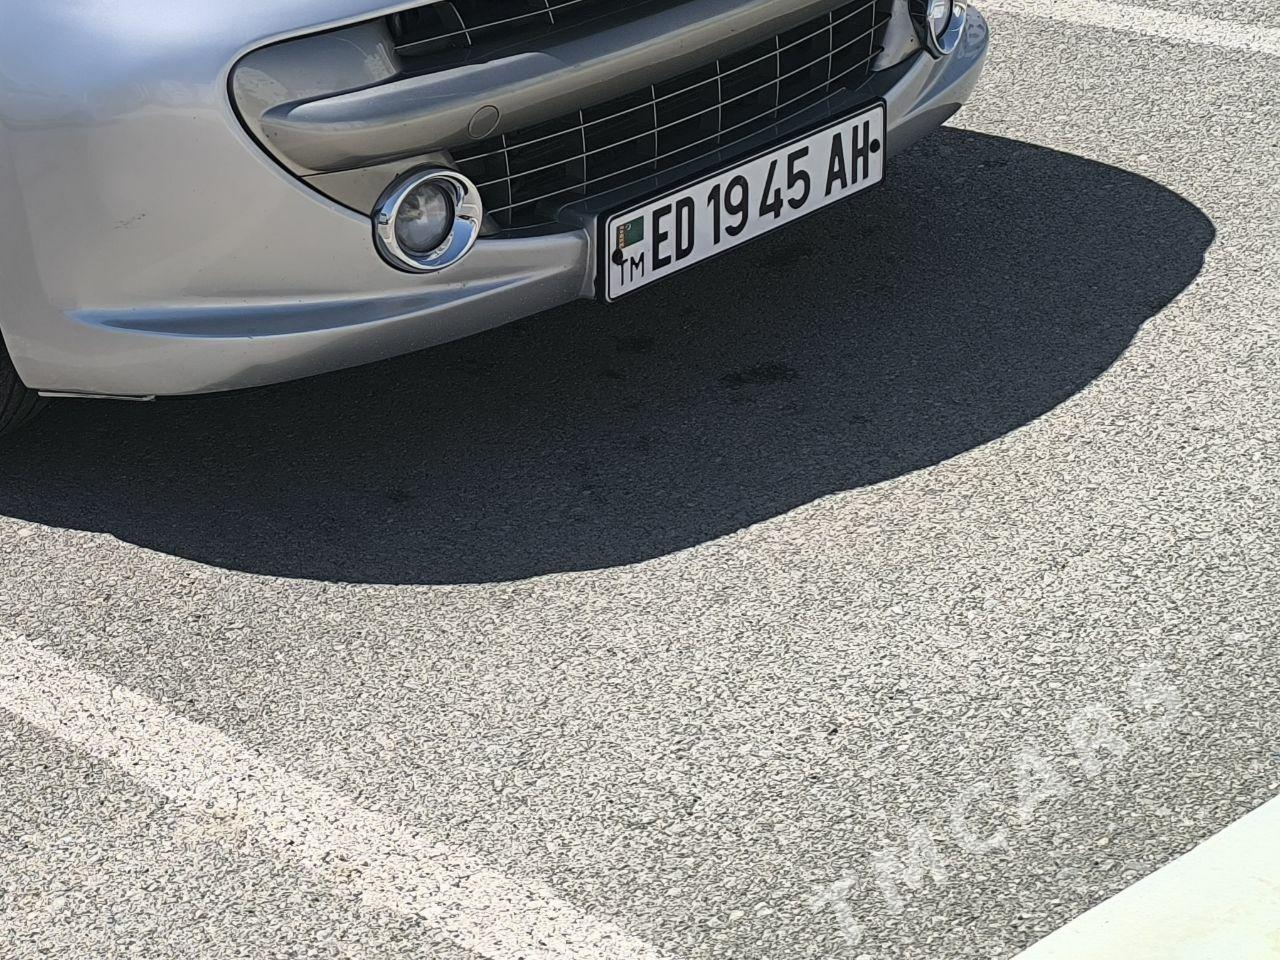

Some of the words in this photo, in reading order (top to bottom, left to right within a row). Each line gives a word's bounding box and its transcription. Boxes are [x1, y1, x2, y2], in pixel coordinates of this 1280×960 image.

[652, 196, 695, 271] ED
[825, 120, 870, 196] AH
[619, 251, 645, 286] TM
